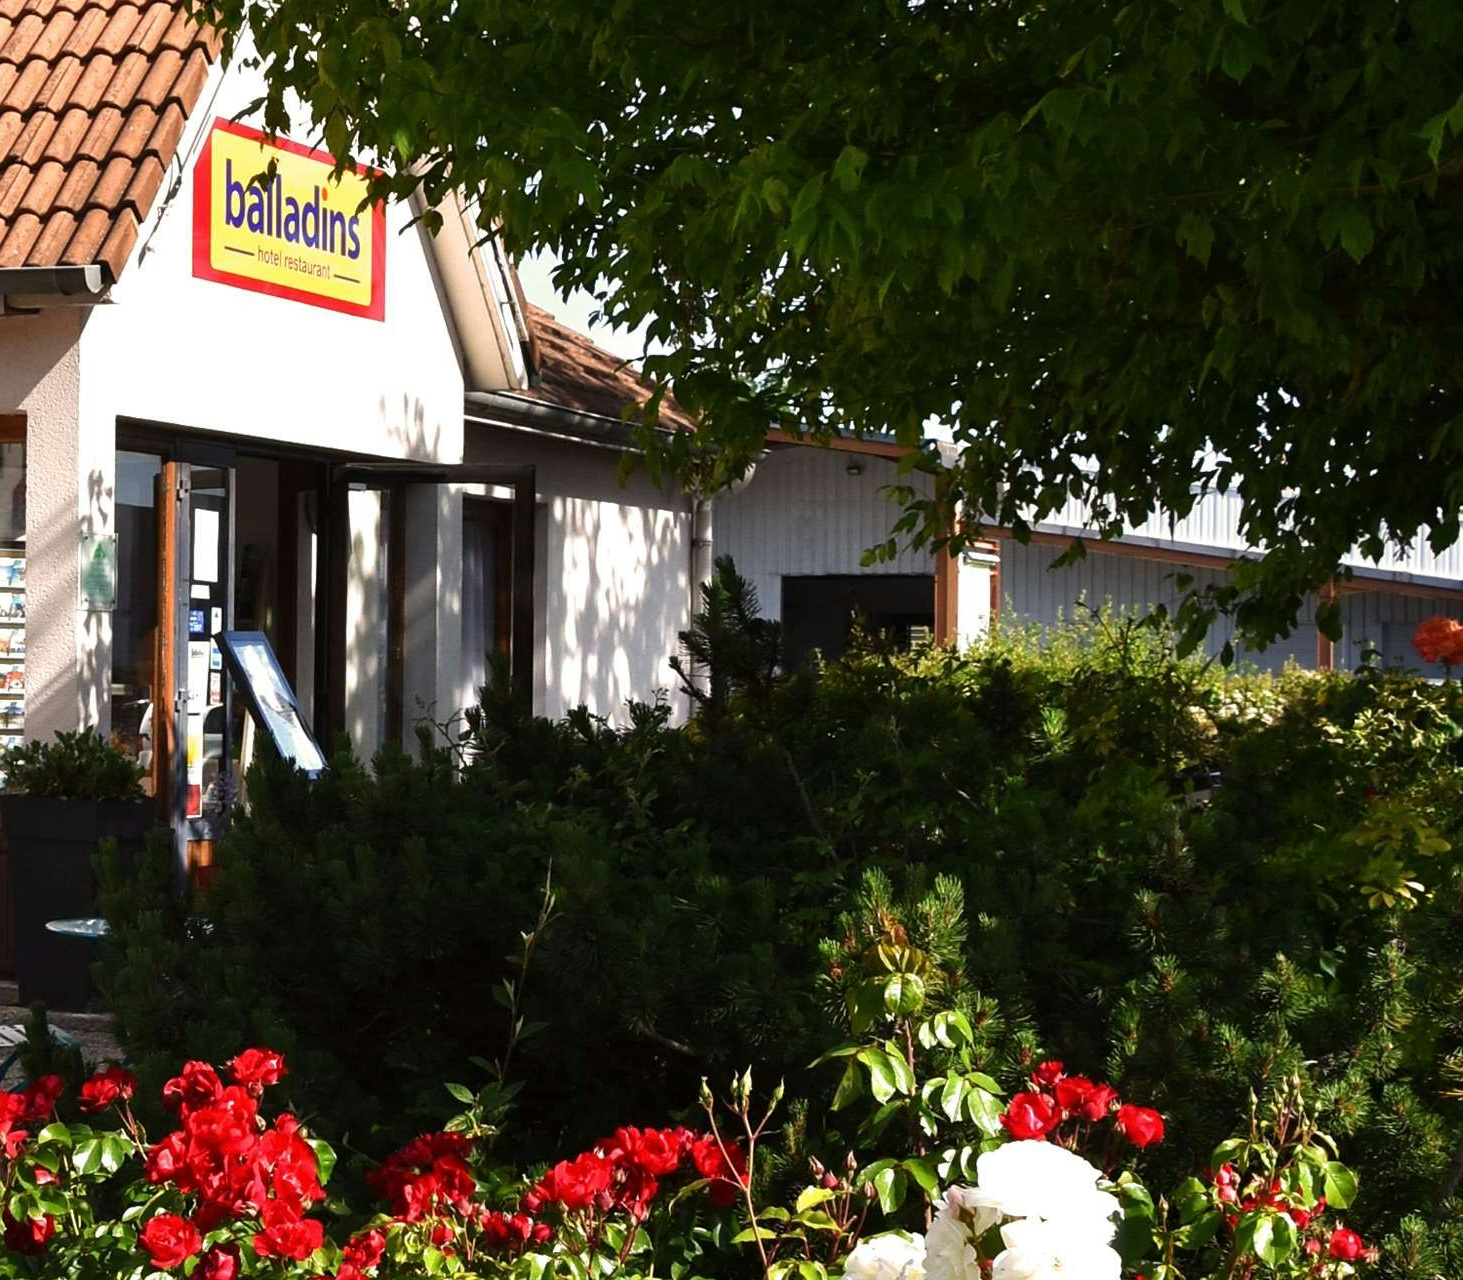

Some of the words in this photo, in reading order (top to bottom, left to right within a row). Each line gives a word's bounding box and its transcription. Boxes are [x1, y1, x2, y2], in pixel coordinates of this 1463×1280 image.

[225, 158, 360, 260] balladins
[257, 245, 283, 267] hotel
[284, 253, 331, 280] restaurant
